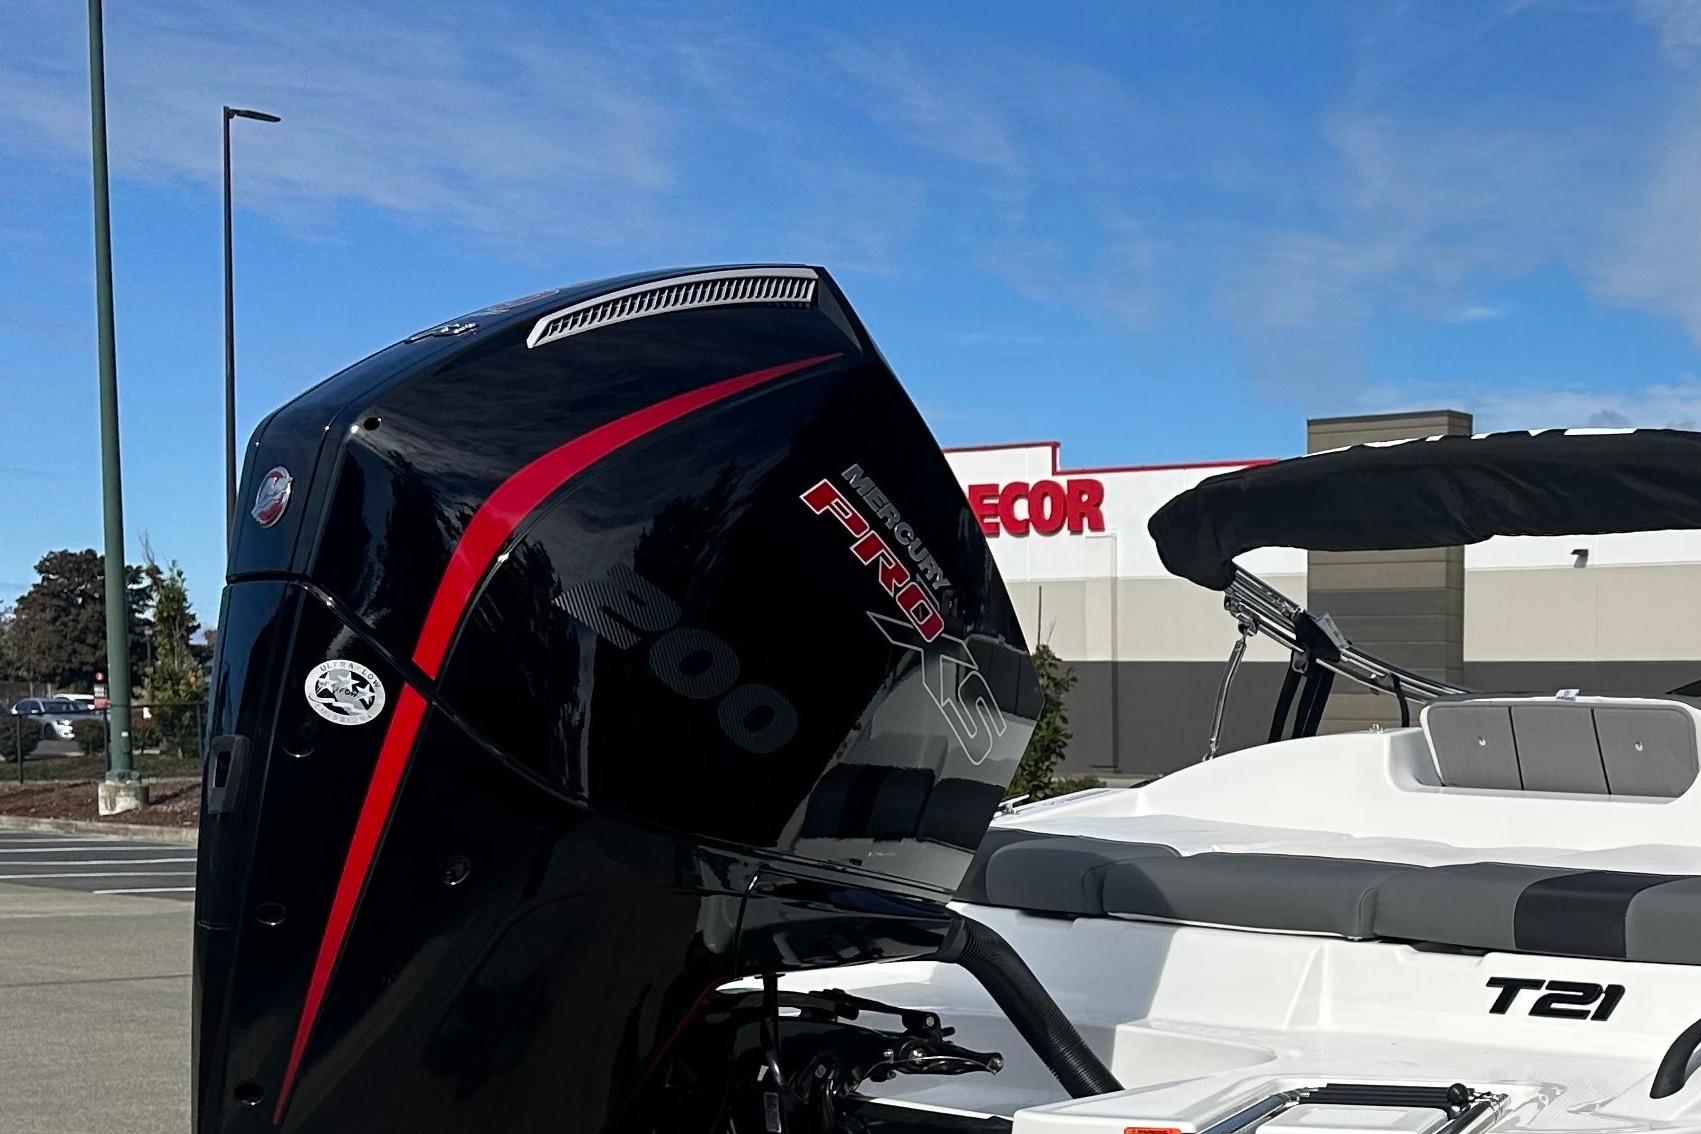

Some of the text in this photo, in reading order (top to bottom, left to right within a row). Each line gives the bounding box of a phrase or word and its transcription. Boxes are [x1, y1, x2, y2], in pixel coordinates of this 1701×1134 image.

[841, 463, 951, 590] MERCURY
[551, 562, 799, 754] 200
[799, 478, 1008, 765] PRO XS
[1486, 976, 1626, 1022] T21
